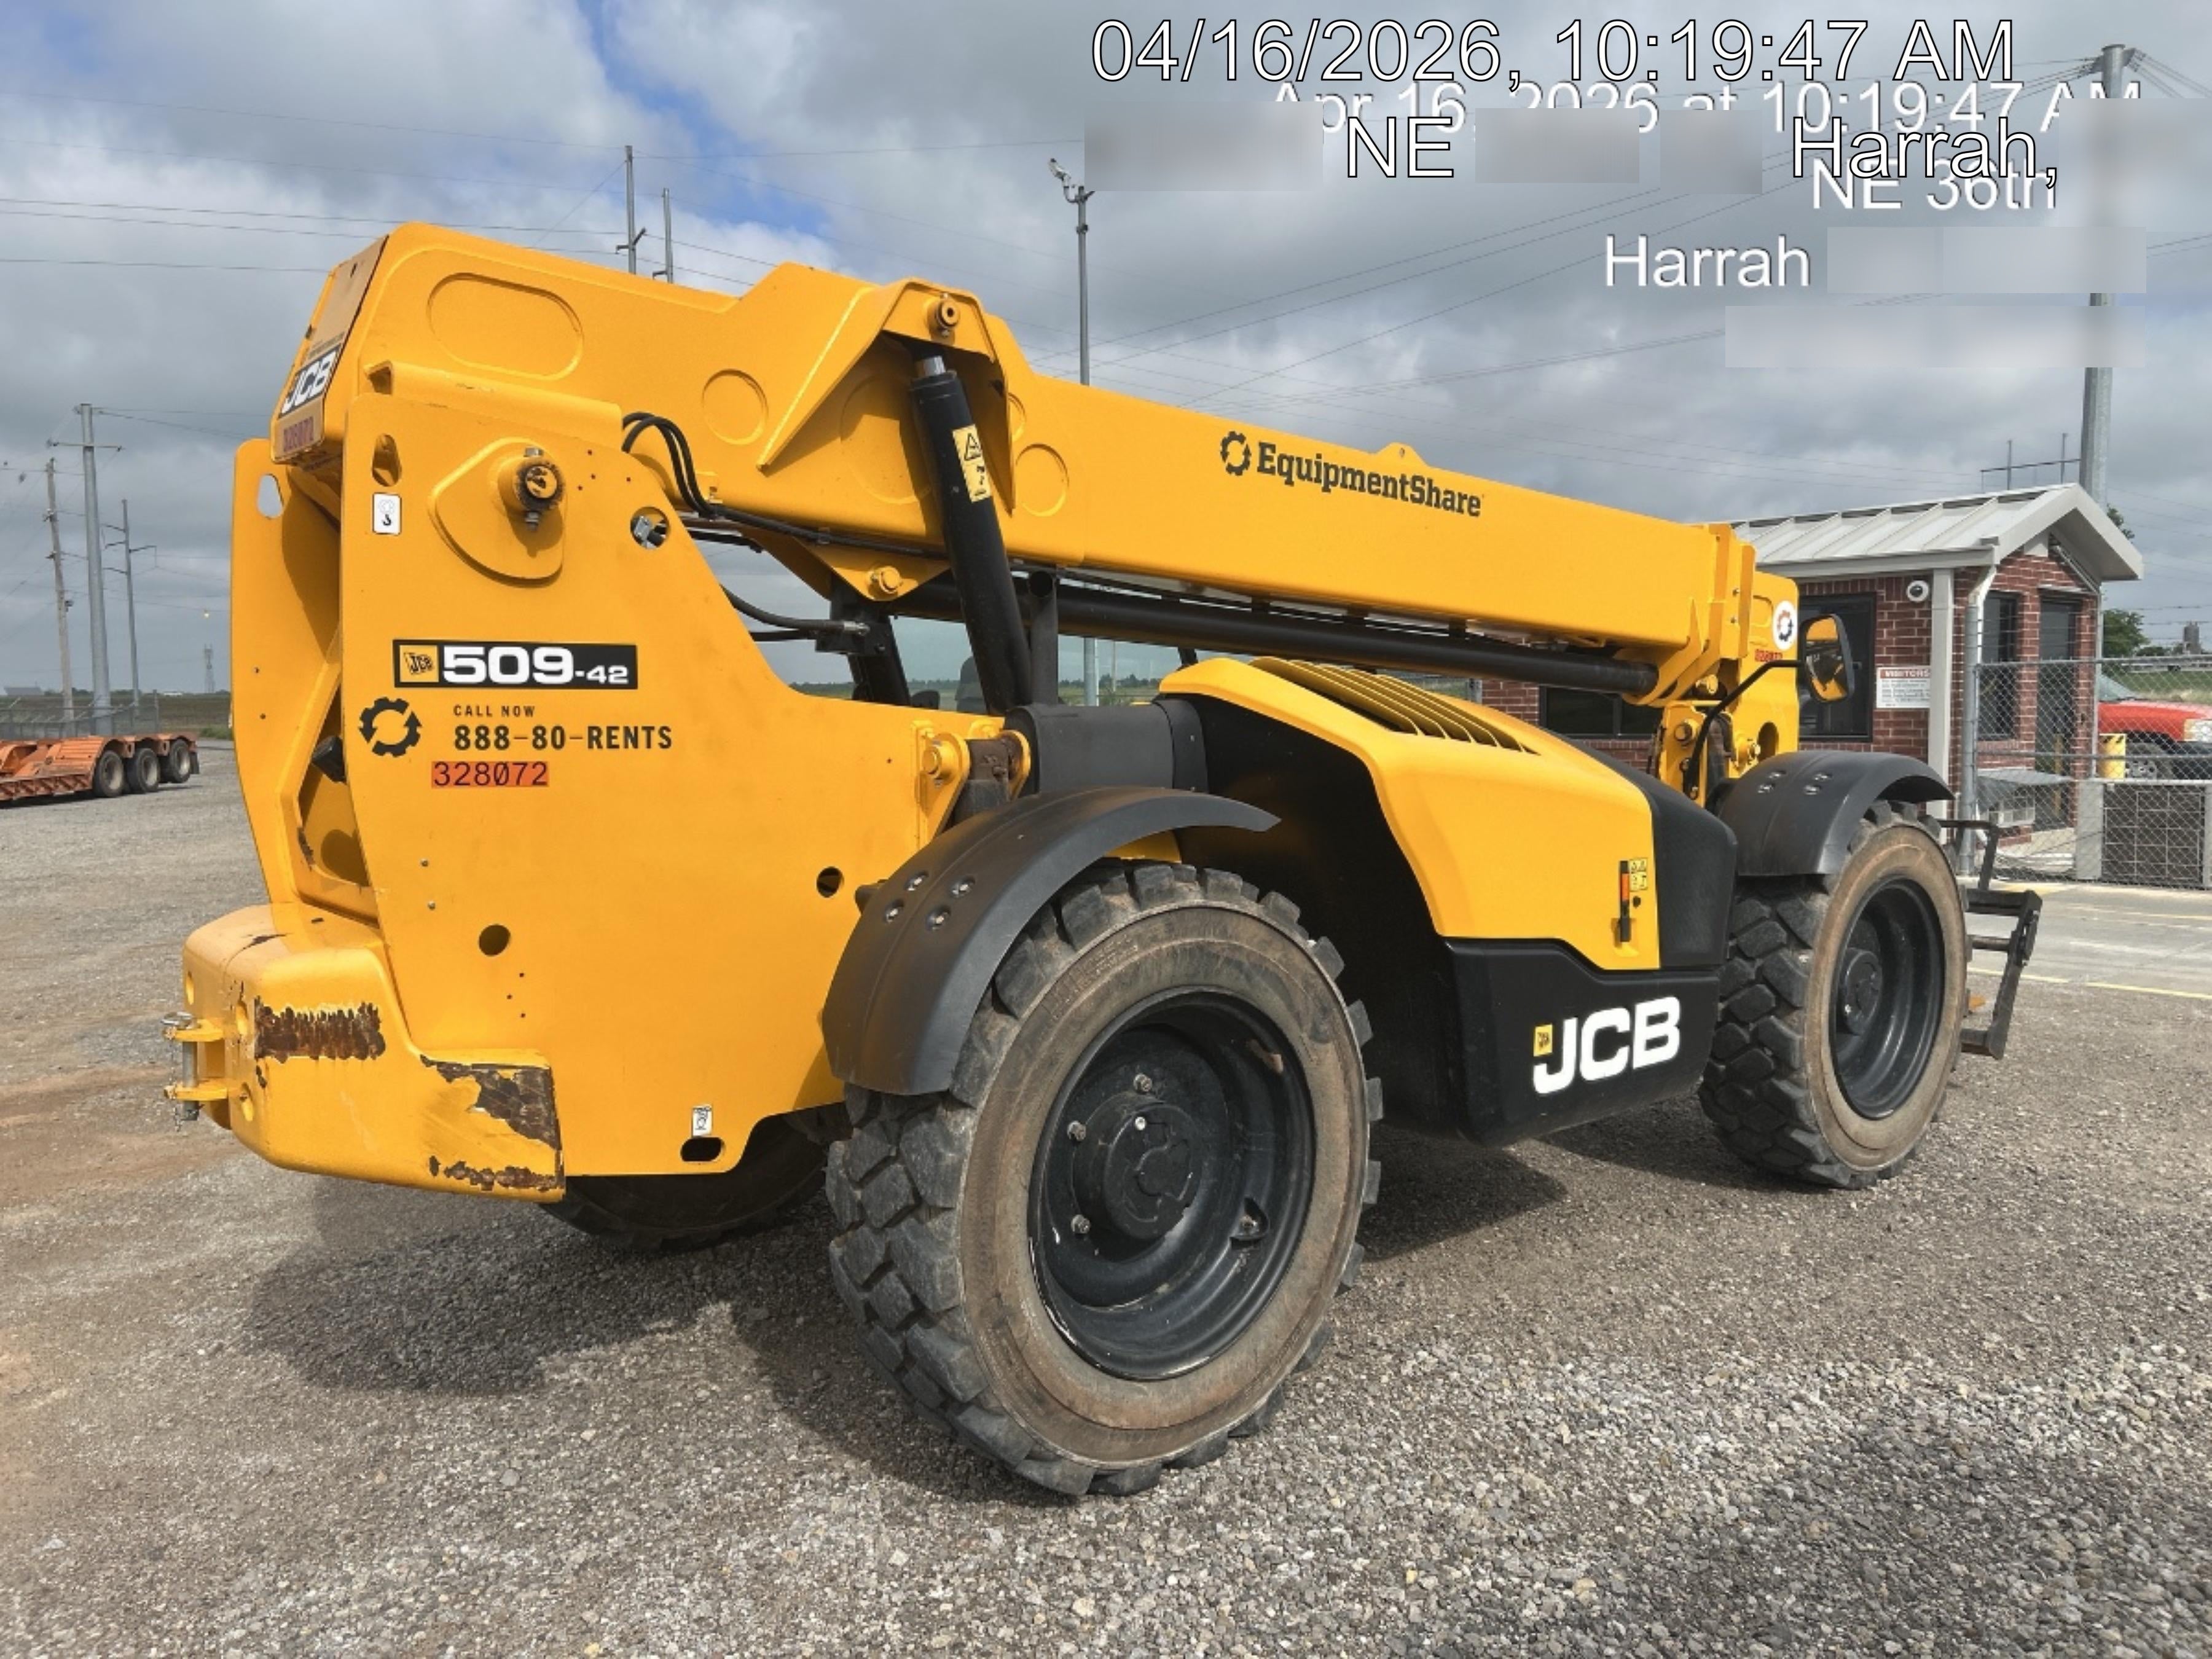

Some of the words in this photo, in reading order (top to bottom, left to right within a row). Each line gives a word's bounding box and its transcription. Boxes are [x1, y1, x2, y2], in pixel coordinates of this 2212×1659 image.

[1257, 441, 1481, 517] EquipmentShare
[442, 646, 629, 684] 509-42
[453, 705, 492, 717] CALL
[501, 705, 535, 717] NOW
[454, 725, 672, 750] 888-80-RENTS
[433, 761, 548, 786] 328072
[1533, 996, 1681, 1094] JCB
